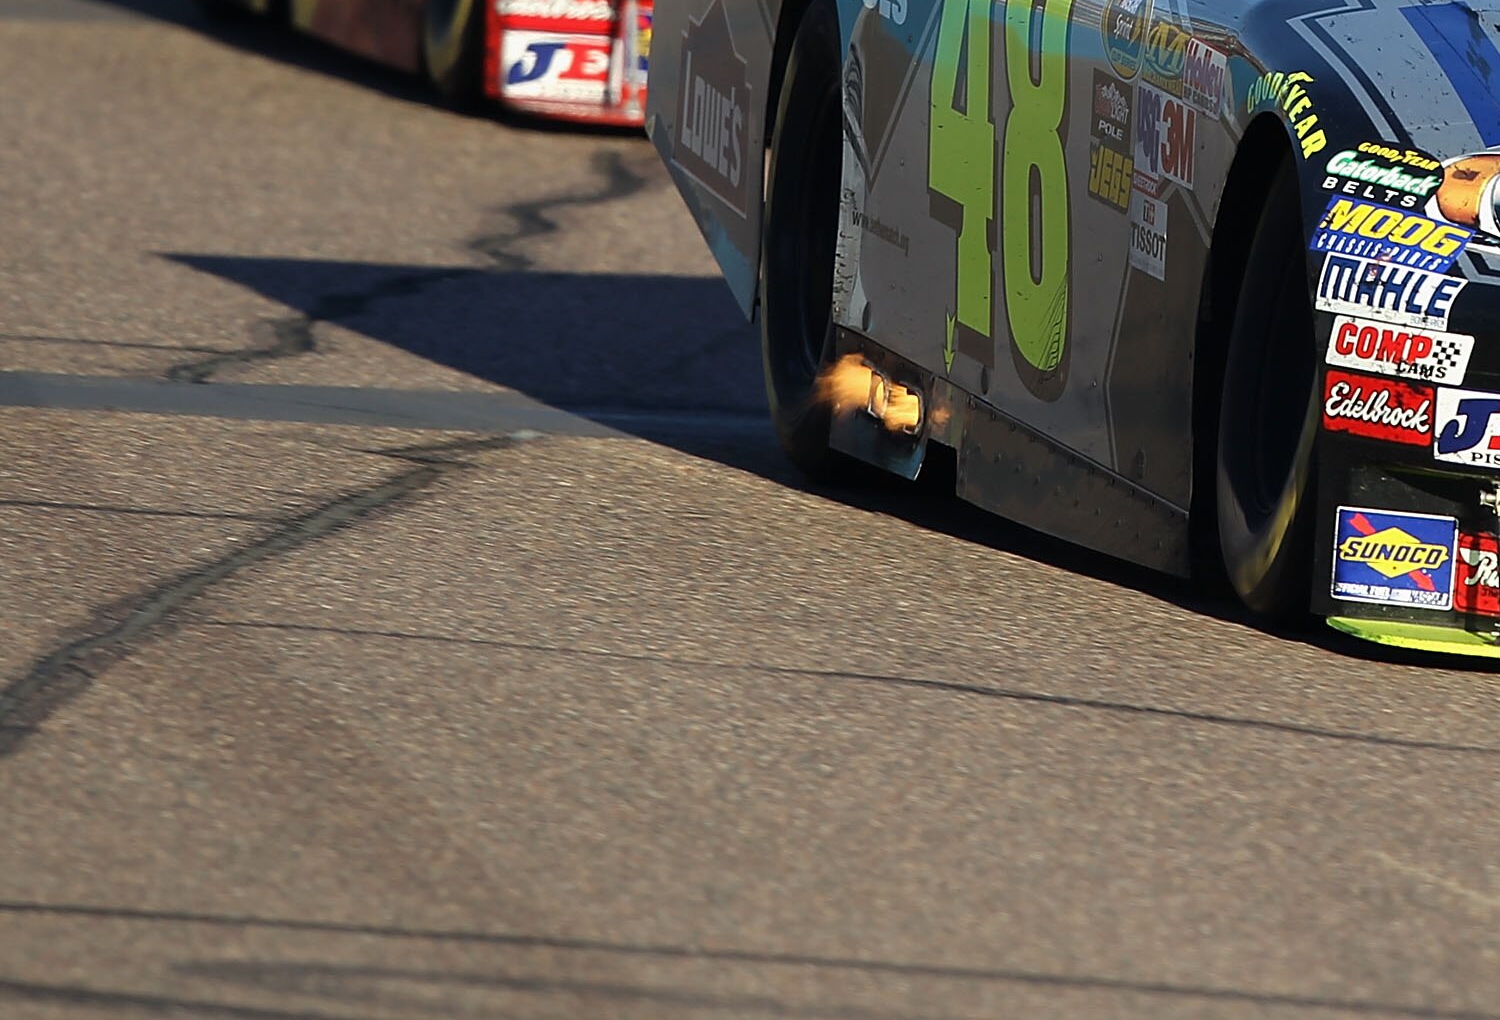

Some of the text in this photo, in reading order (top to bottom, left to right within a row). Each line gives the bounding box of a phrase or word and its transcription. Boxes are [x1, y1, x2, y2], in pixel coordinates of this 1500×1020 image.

[1098, 120, 1124, 141] POLE
[1246, 71, 1328, 160] GOODYEAR
[1160, 99, 1197, 185] 3M
[1358, 142, 1440, 170] GOODYEAR
[1089, 143, 1134, 209] JEGS
[1322, 176, 1418, 208] BELTS
[1326, 149, 1443, 196] Gatorback
[1131, 222, 1166, 262] TISSOT
[1320, 199, 1472, 257] MOOG
[1317, 232, 1443, 271] CHASSIS PARTS
[1320, 255, 1463, 318] MAHLE
[1335, 322, 1434, 364] COMP
[1396, 360, 1448, 379] CAMS
[1325, 382, 1431, 433] Edelbrock
[1346, 541, 1443, 565] SUNOCO
